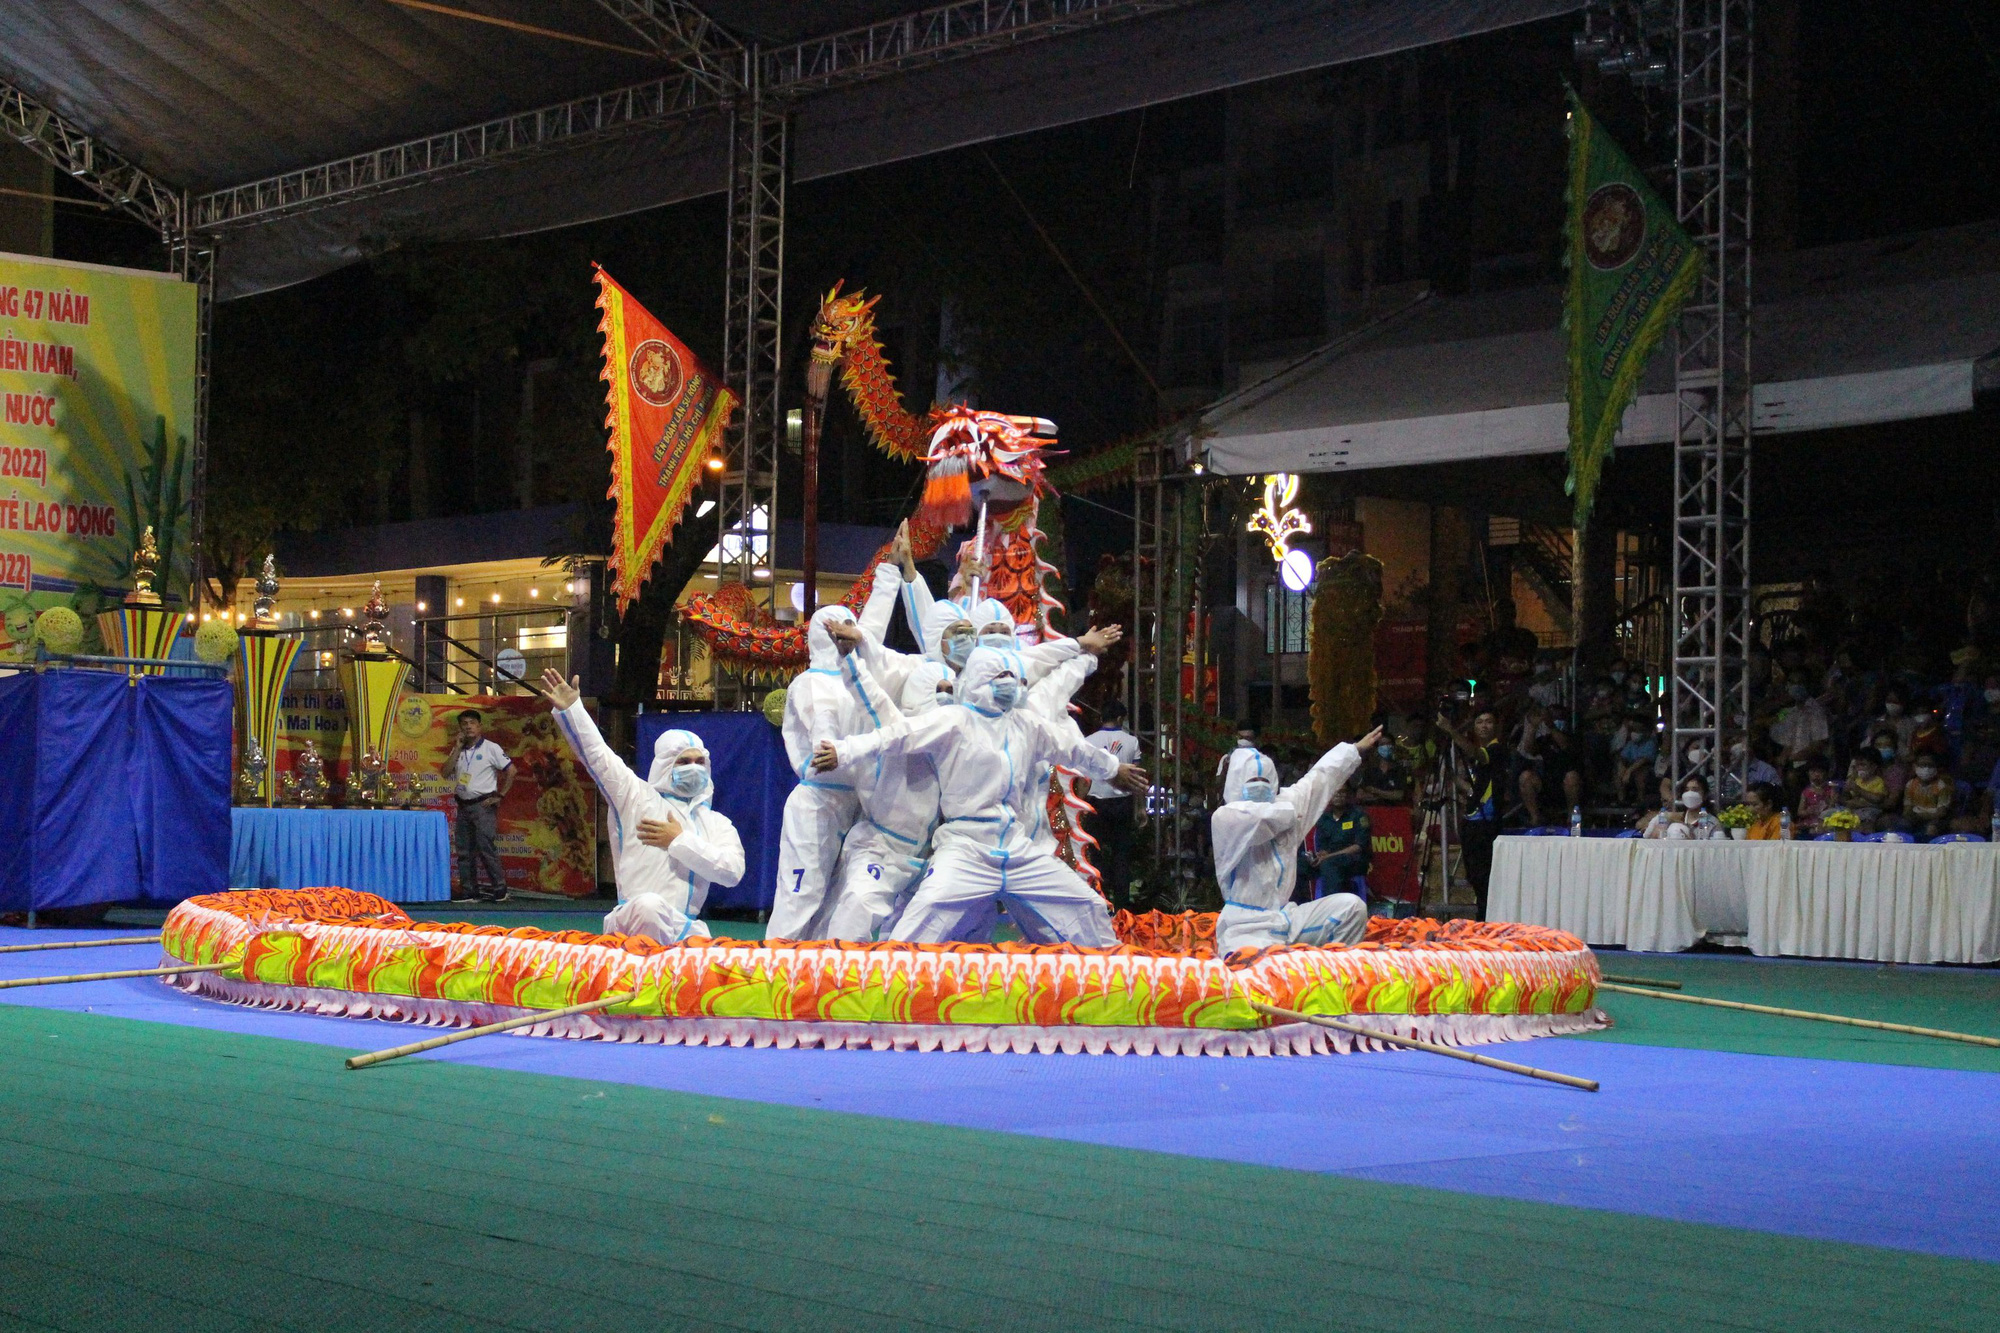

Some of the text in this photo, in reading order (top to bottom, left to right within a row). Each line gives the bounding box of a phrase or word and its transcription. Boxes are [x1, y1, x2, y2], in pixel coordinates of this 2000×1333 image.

[23, 289, 44, 320] 47
[48, 288, 89, 325] NĂM
[33, 343, 78, 382] NAM,
[6, 390, 56, 428] NƯỚC
[24, 501, 62, 533] LAO
[66, 500, 116, 540] ĐỘNG
[287, 715, 310, 730] Mai
[315, 715, 338, 731] Hoa
[793, 868, 805, 892] 7
